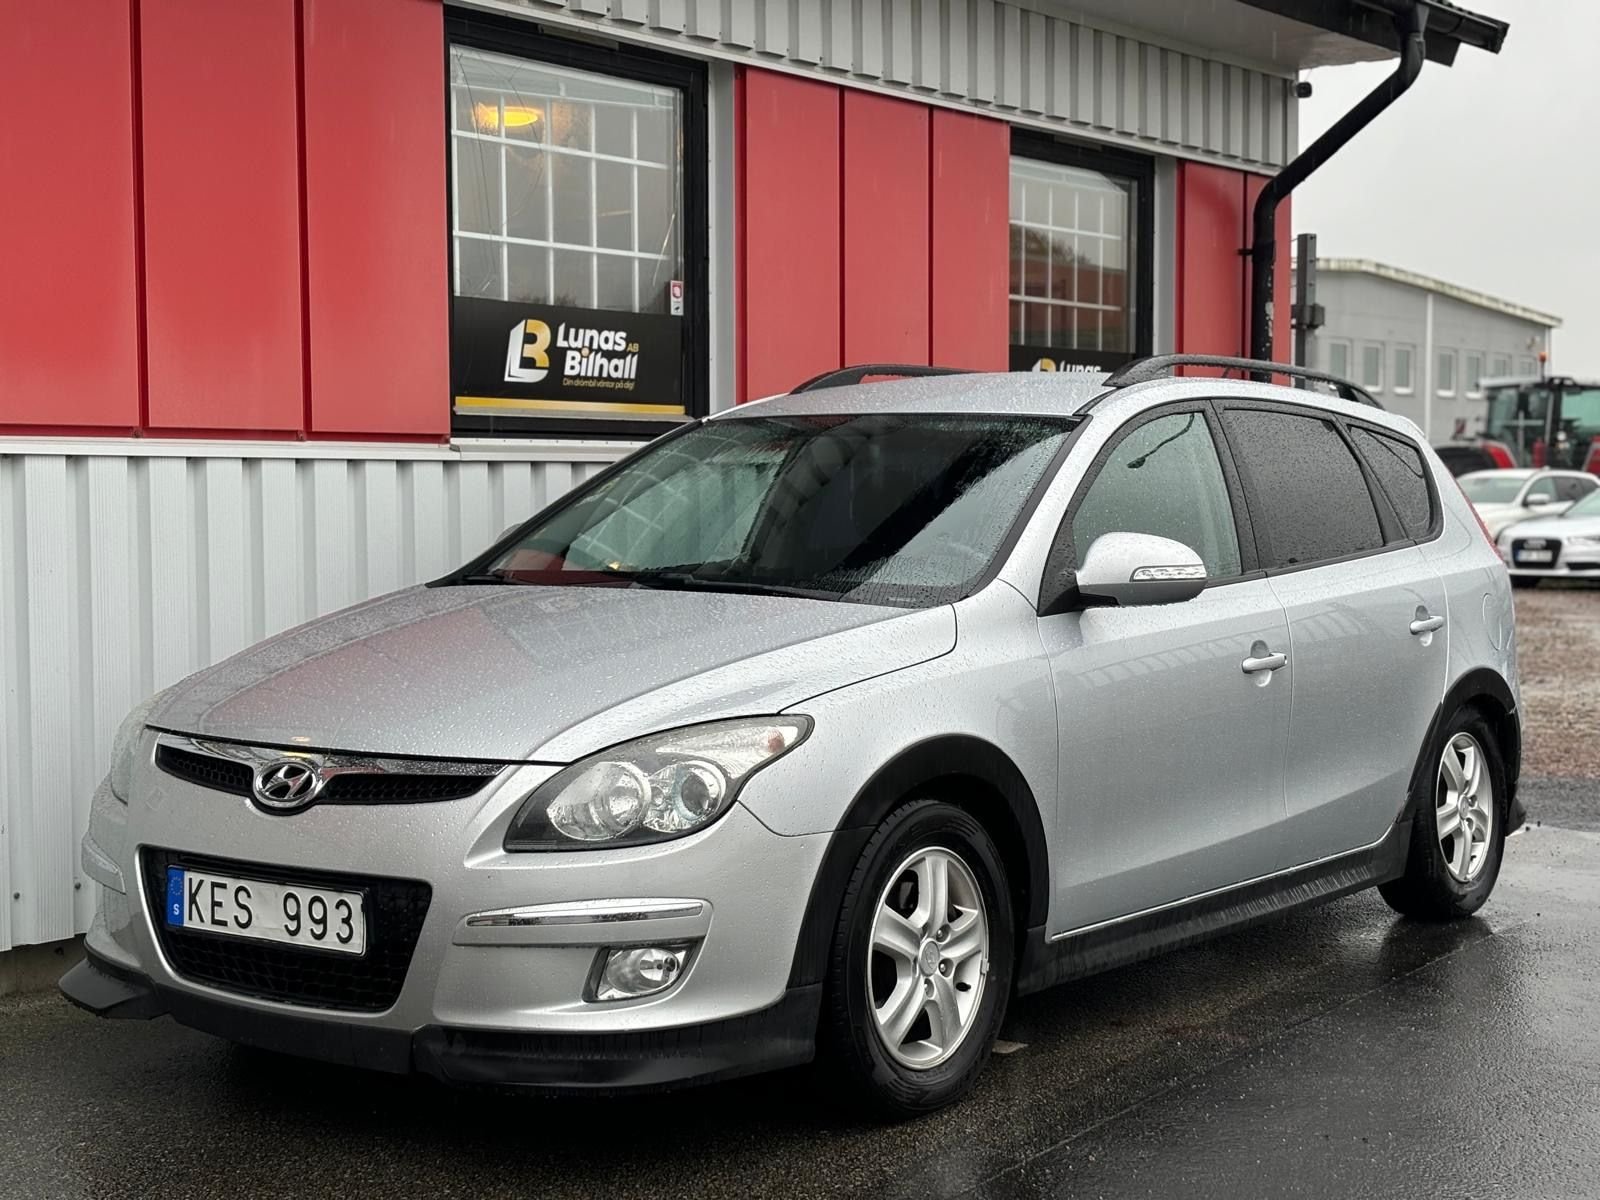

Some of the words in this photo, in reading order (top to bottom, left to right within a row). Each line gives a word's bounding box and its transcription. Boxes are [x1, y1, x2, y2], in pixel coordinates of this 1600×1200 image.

[556, 322, 627, 352] Lunas
[627, 343, 639, 353] AB
[564, 346, 639, 379] Bilhall
[563, 377, 573, 386] Din
[615, 380, 624, 390] på
[173, 903, 180, 916] S
[188, 877, 253, 930] KES
[283, 891, 354, 944] 993
